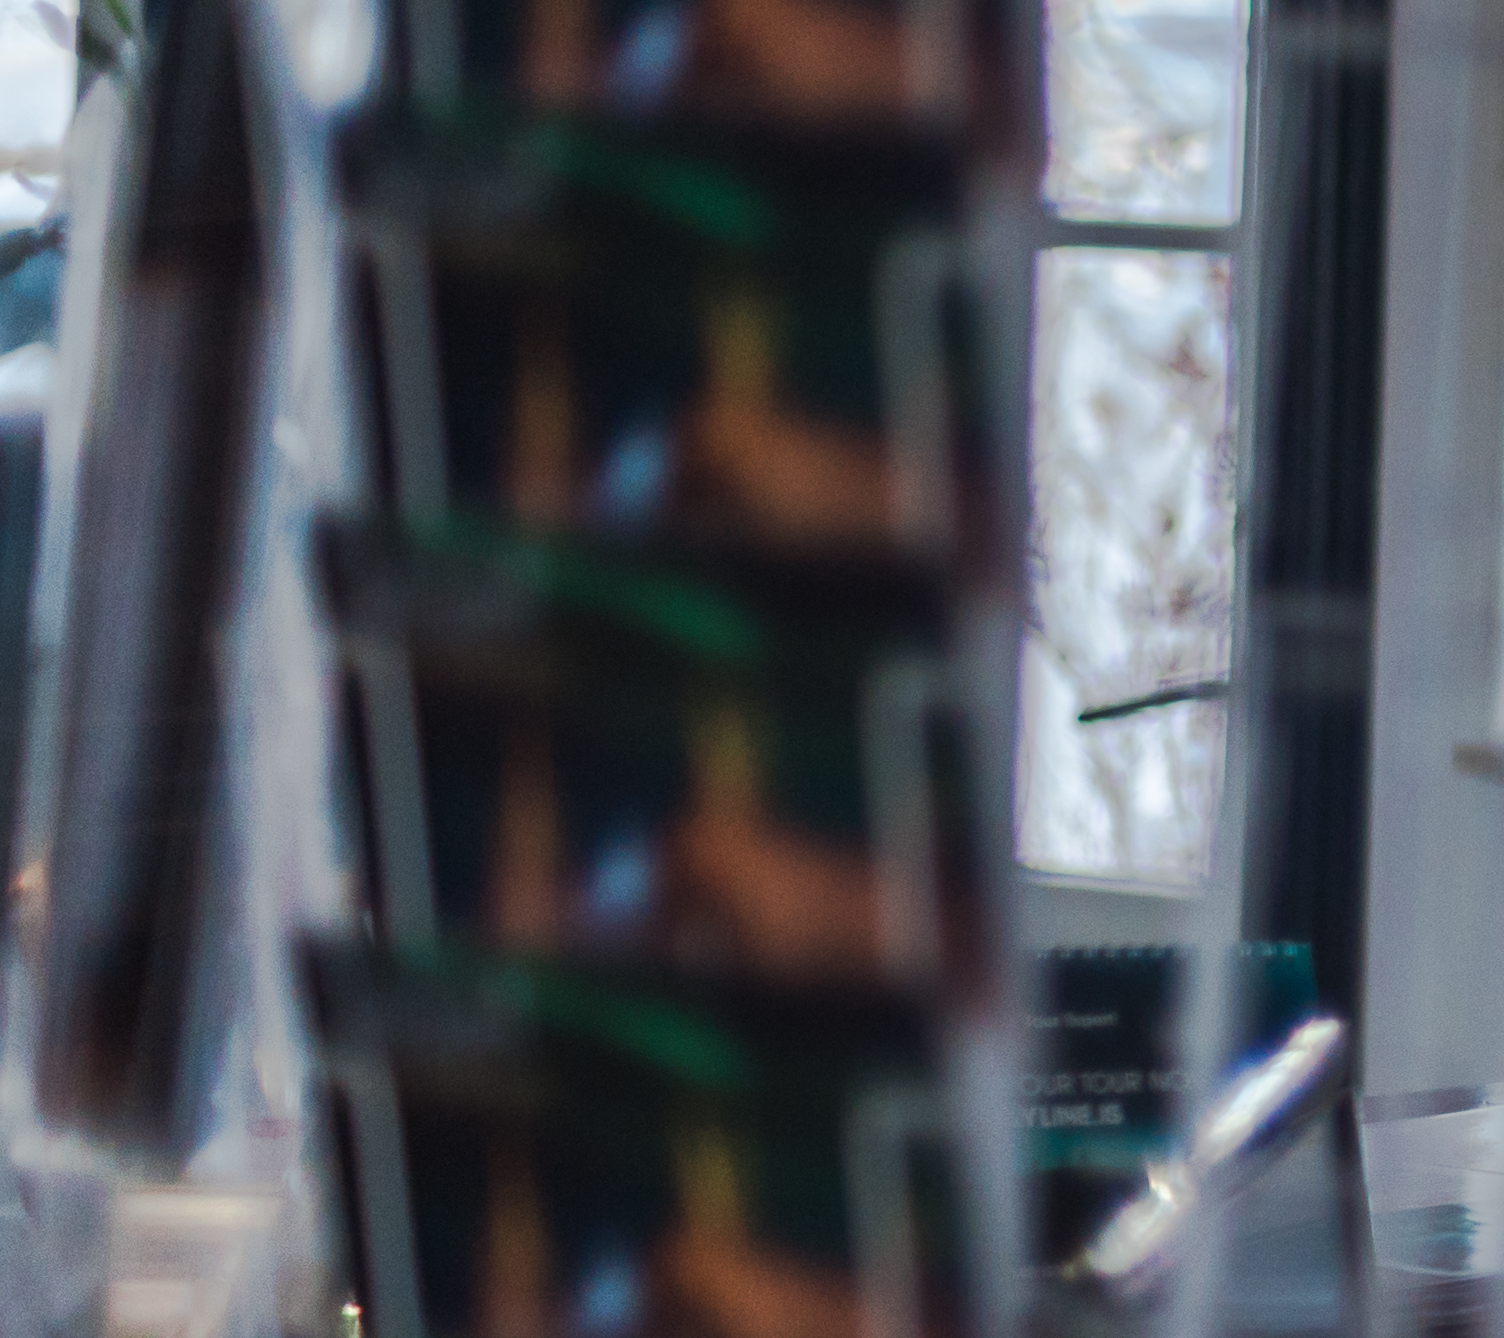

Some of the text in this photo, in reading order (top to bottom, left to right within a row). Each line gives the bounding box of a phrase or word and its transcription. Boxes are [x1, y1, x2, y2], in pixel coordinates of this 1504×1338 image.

[1021, 1072, 1076, 1097] OUR
[1079, 1070, 1142, 1094] TOUR
[1021, 1103, 1125, 1128] YLINE.IS
